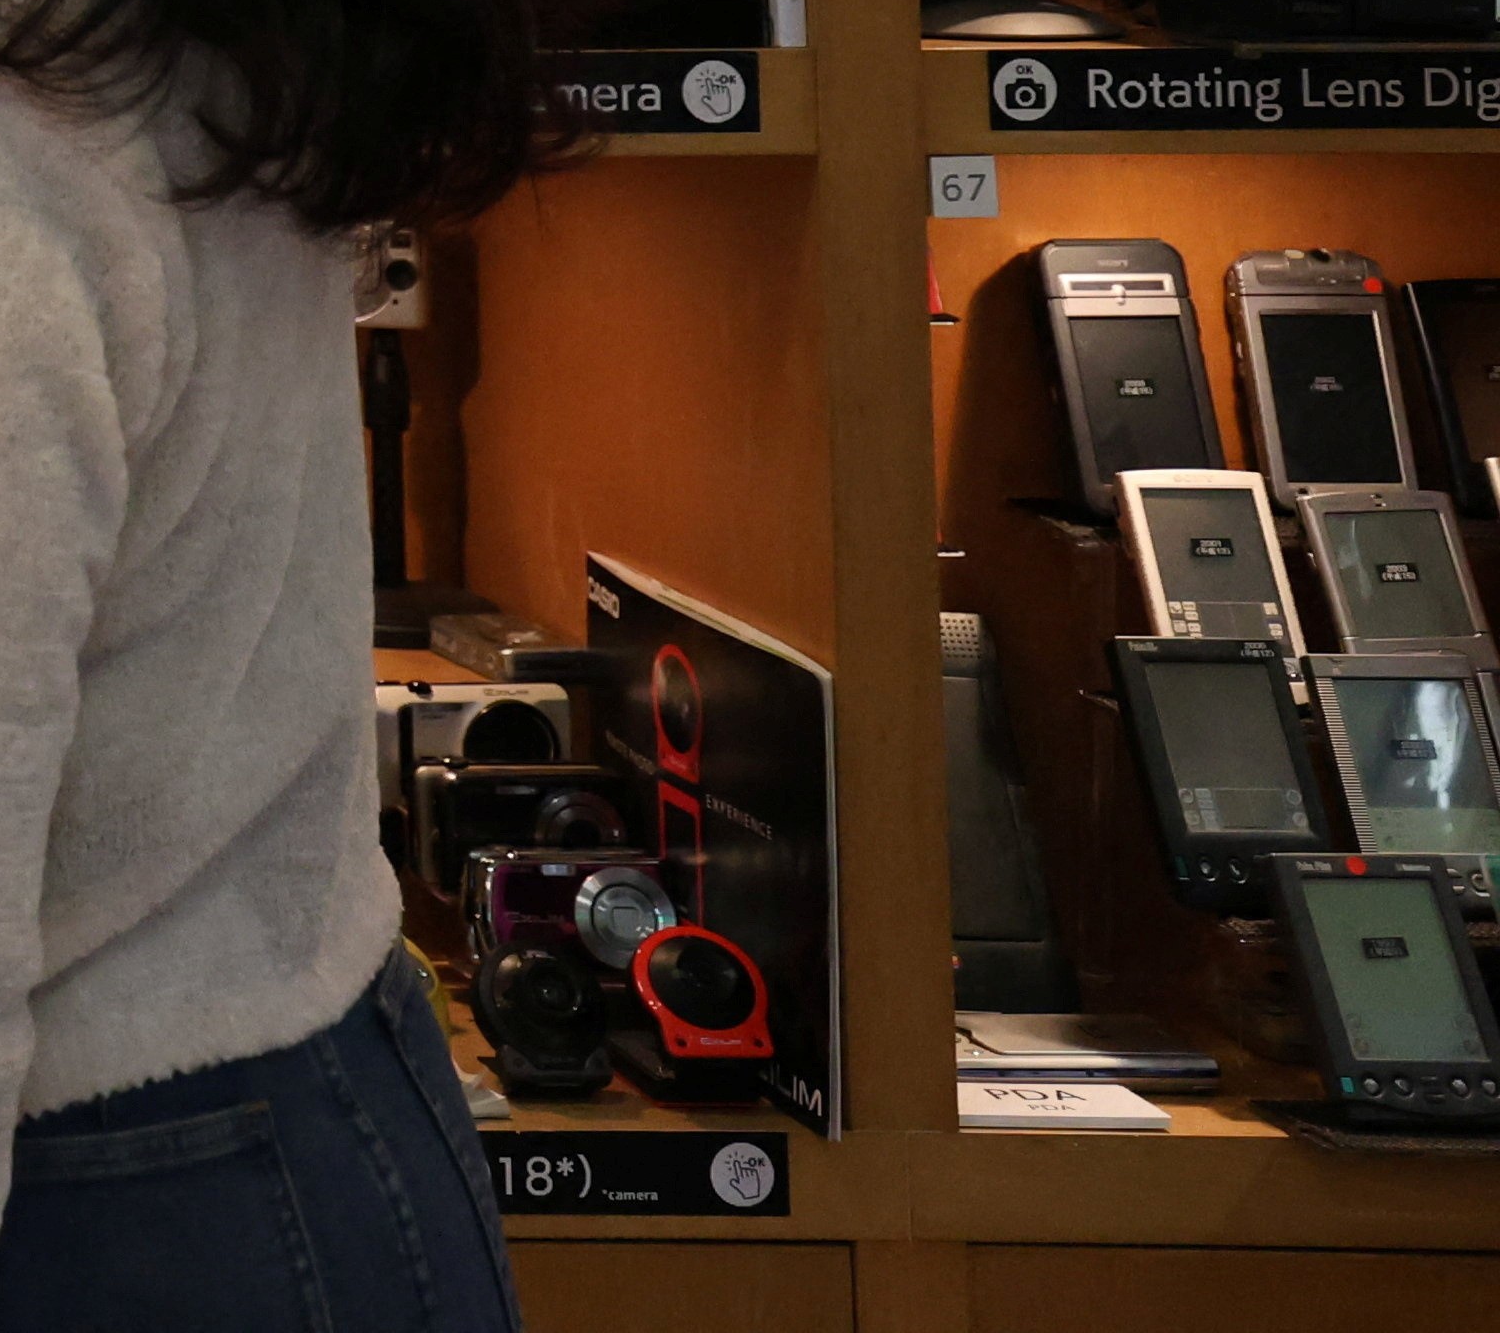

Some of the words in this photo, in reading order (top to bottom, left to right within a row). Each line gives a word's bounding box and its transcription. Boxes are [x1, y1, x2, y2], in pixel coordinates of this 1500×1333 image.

[1087, 66, 1284, 123] Rotating
[1302, 69, 1405, 109] Lens
[941, 173, 987, 202] 67
[705, 793, 774, 841] EXPERIENCE
[984, 1085, 1088, 1103] PDA
[1028, 1102, 1075, 1113] PDA
